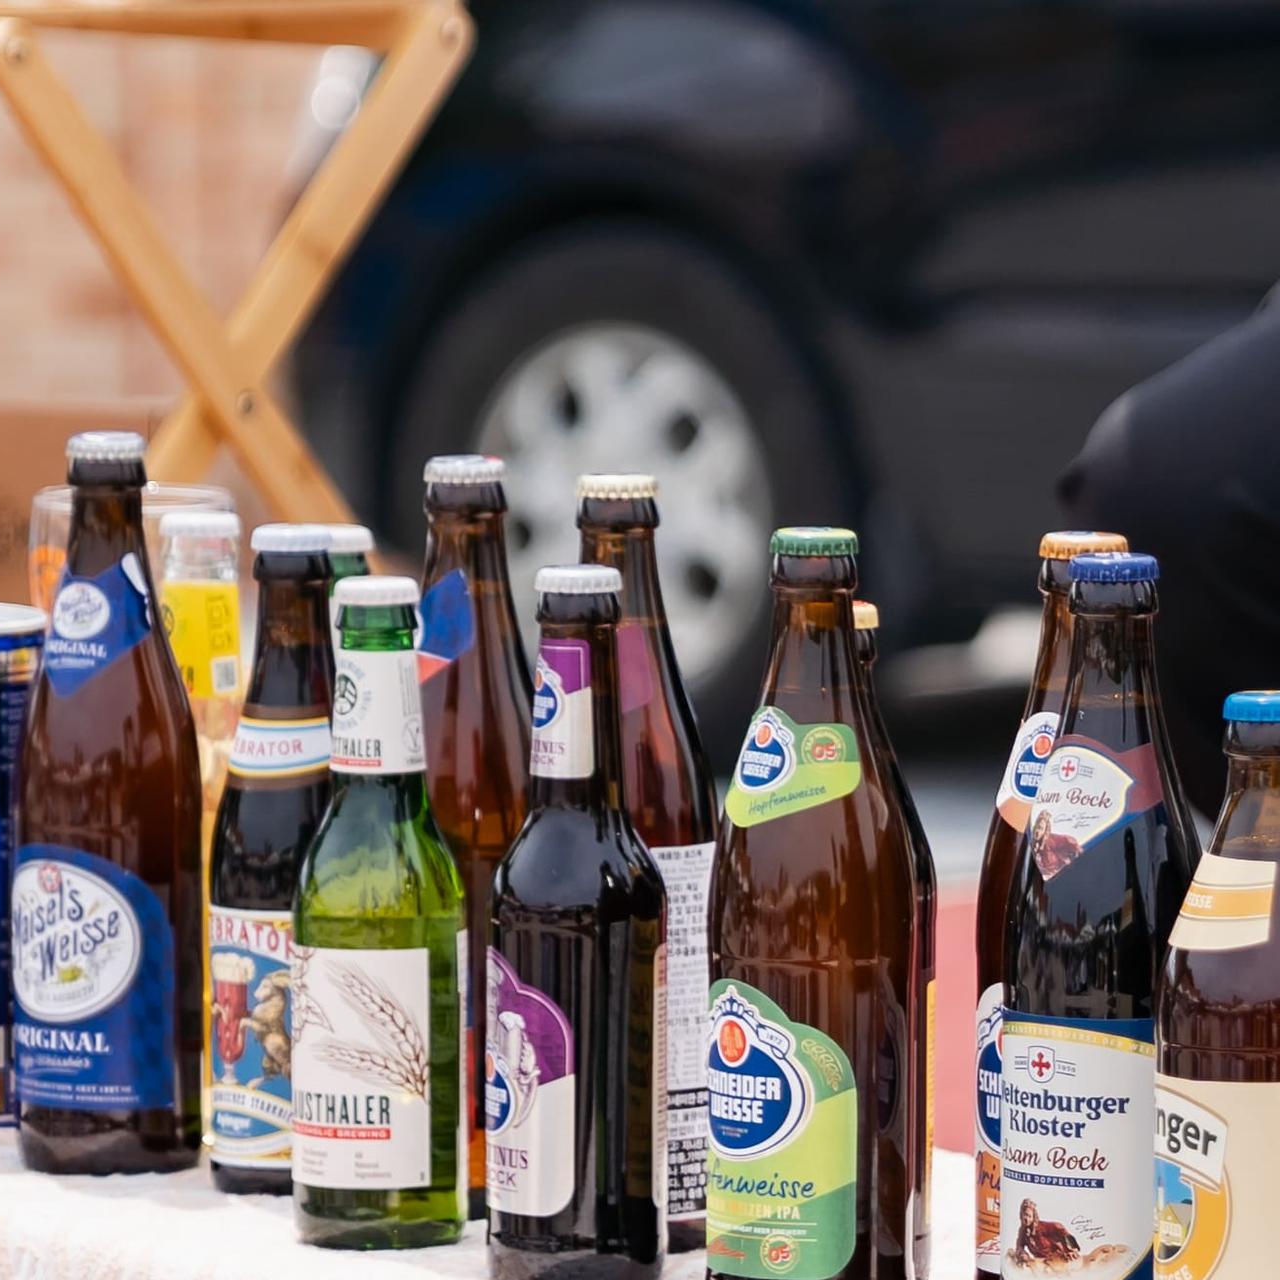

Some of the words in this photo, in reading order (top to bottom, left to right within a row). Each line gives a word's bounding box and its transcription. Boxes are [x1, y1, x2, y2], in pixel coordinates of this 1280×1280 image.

[1037, 791, 1061, 804] sam
[1066, 787, 1113, 809] Bock
[1009, 1108, 1087, 1139] Kloster
[338, 1128, 387, 1139] BREWING
[1046, 1145, 1110, 1172] Bock
[1033, 1173, 1099, 1189] DOPPELBOCK
[776, 1205, 801, 1220] IPA
